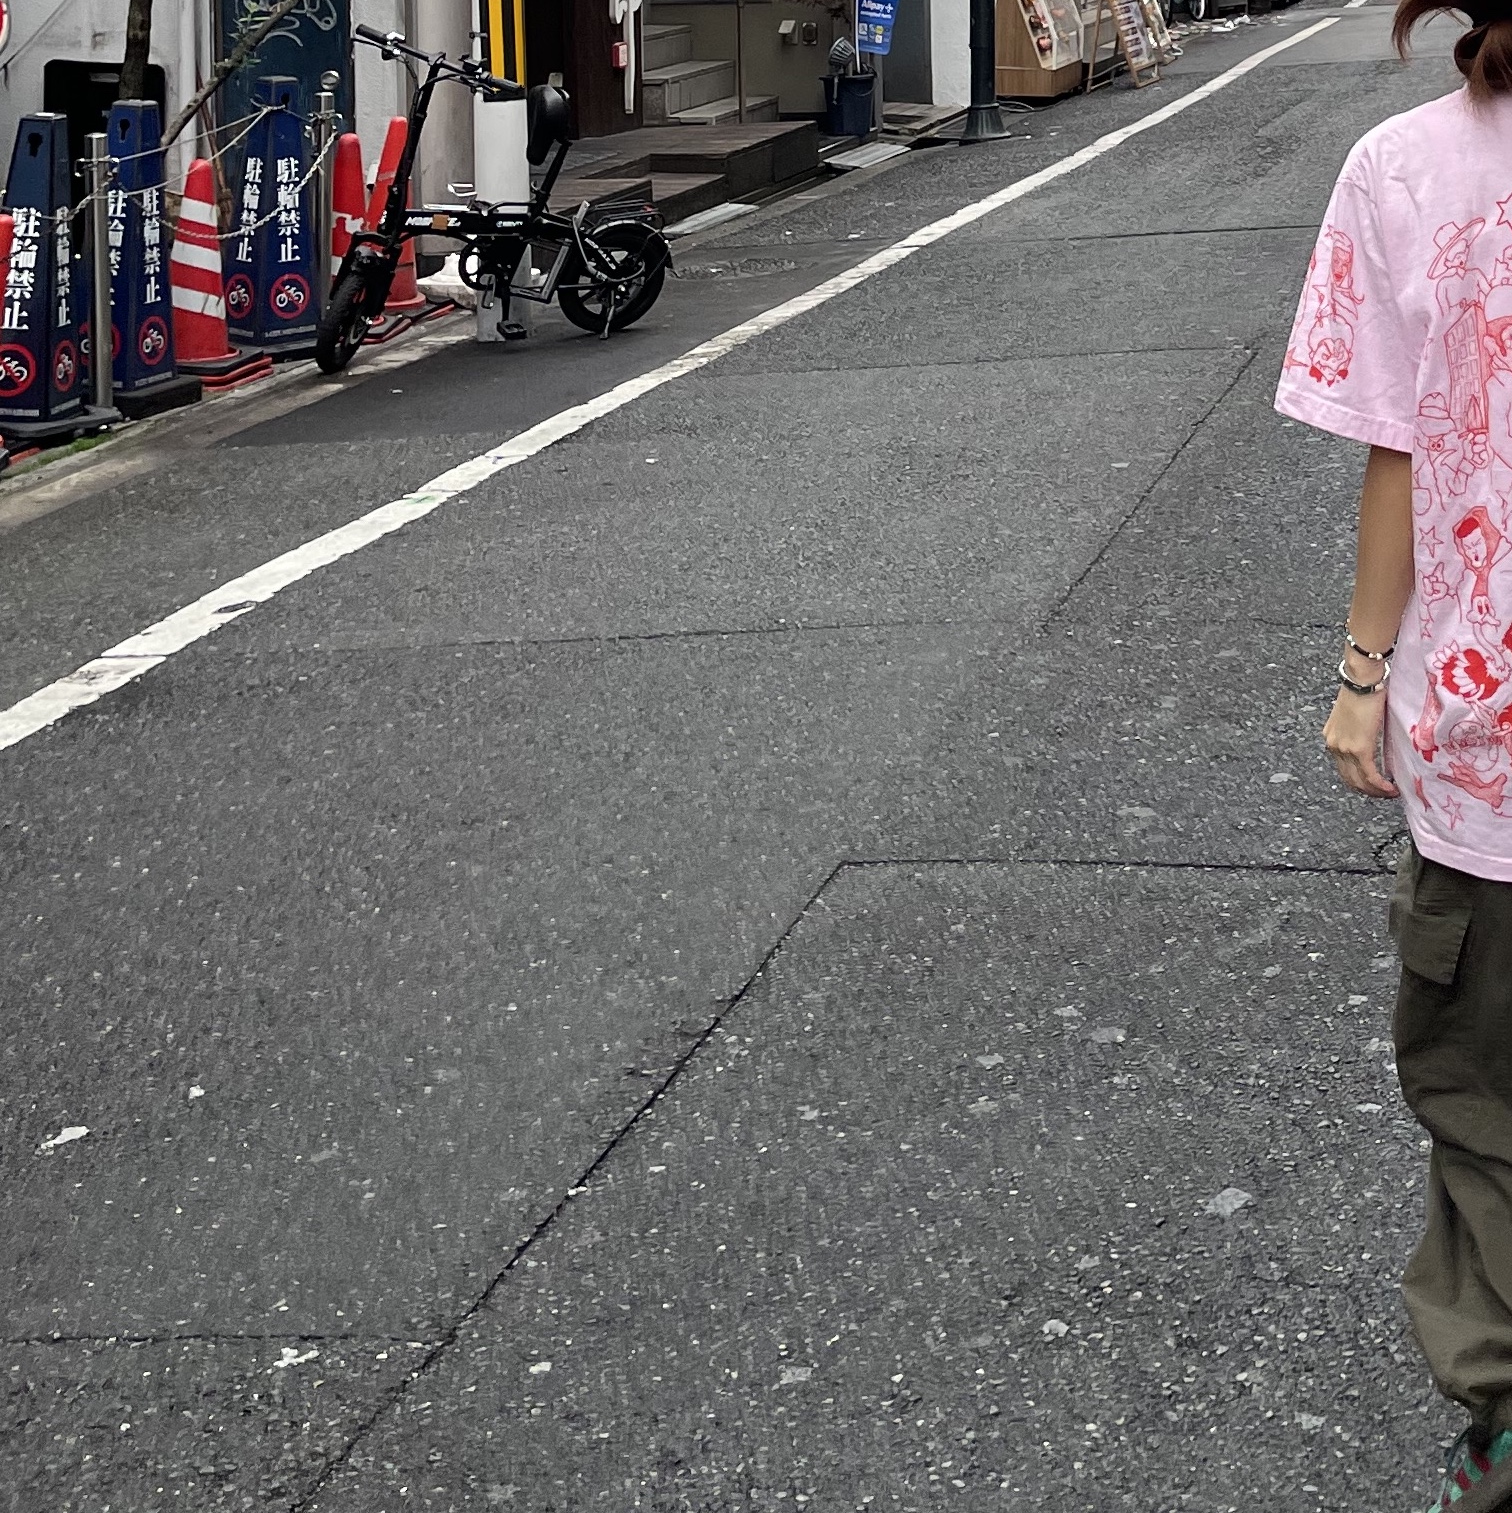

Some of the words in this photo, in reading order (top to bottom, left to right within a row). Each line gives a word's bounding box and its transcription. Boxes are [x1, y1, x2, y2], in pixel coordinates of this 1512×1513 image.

[55, 206, 72, 328] 駐輪禁止
[142, 189, 161, 305] 駐輪禁止
[236, 157, 264, 263] 駐輪禁止
[276, 157, 301, 263] 駐輪禁止
[1, 207, 42, 330] 駐輪禁止
